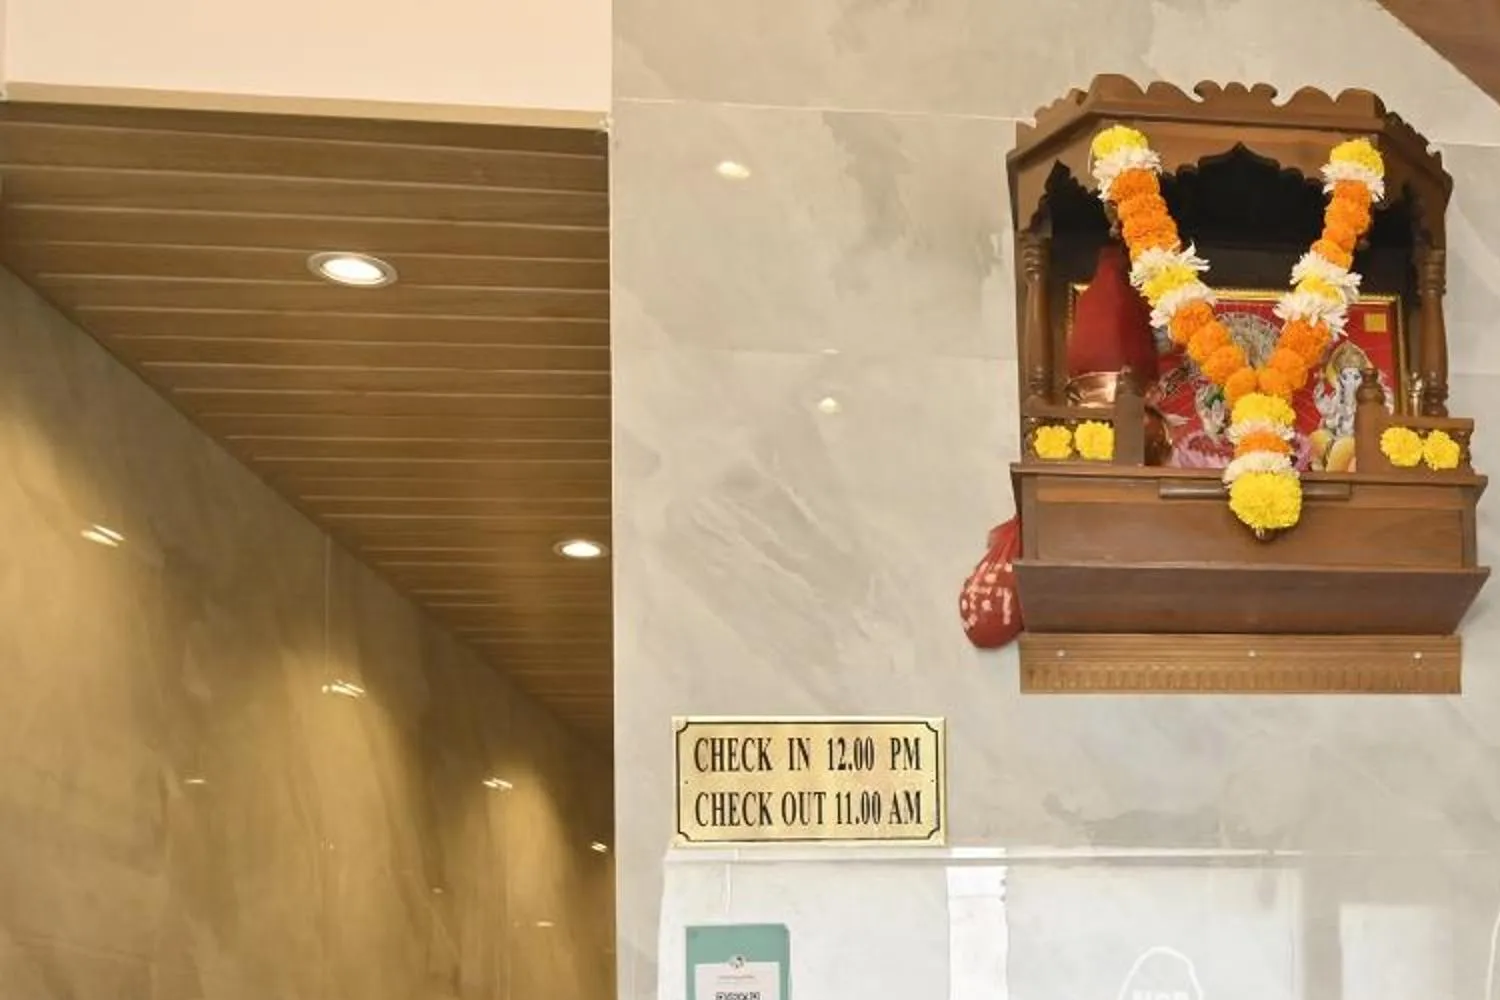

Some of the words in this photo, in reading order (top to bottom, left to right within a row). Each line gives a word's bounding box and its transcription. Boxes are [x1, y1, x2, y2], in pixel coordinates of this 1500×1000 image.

[693, 737, 773, 772] CHECK
[787, 738, 811, 771] IN
[827, 736, 875, 771] 12.00
[889, 737, 922, 771] PM
[694, 791, 773, 827] CHECK
[781, 791, 826, 826] OUT
[835, 791, 882, 826] 11.00
[888, 790, 923, 825] AM
